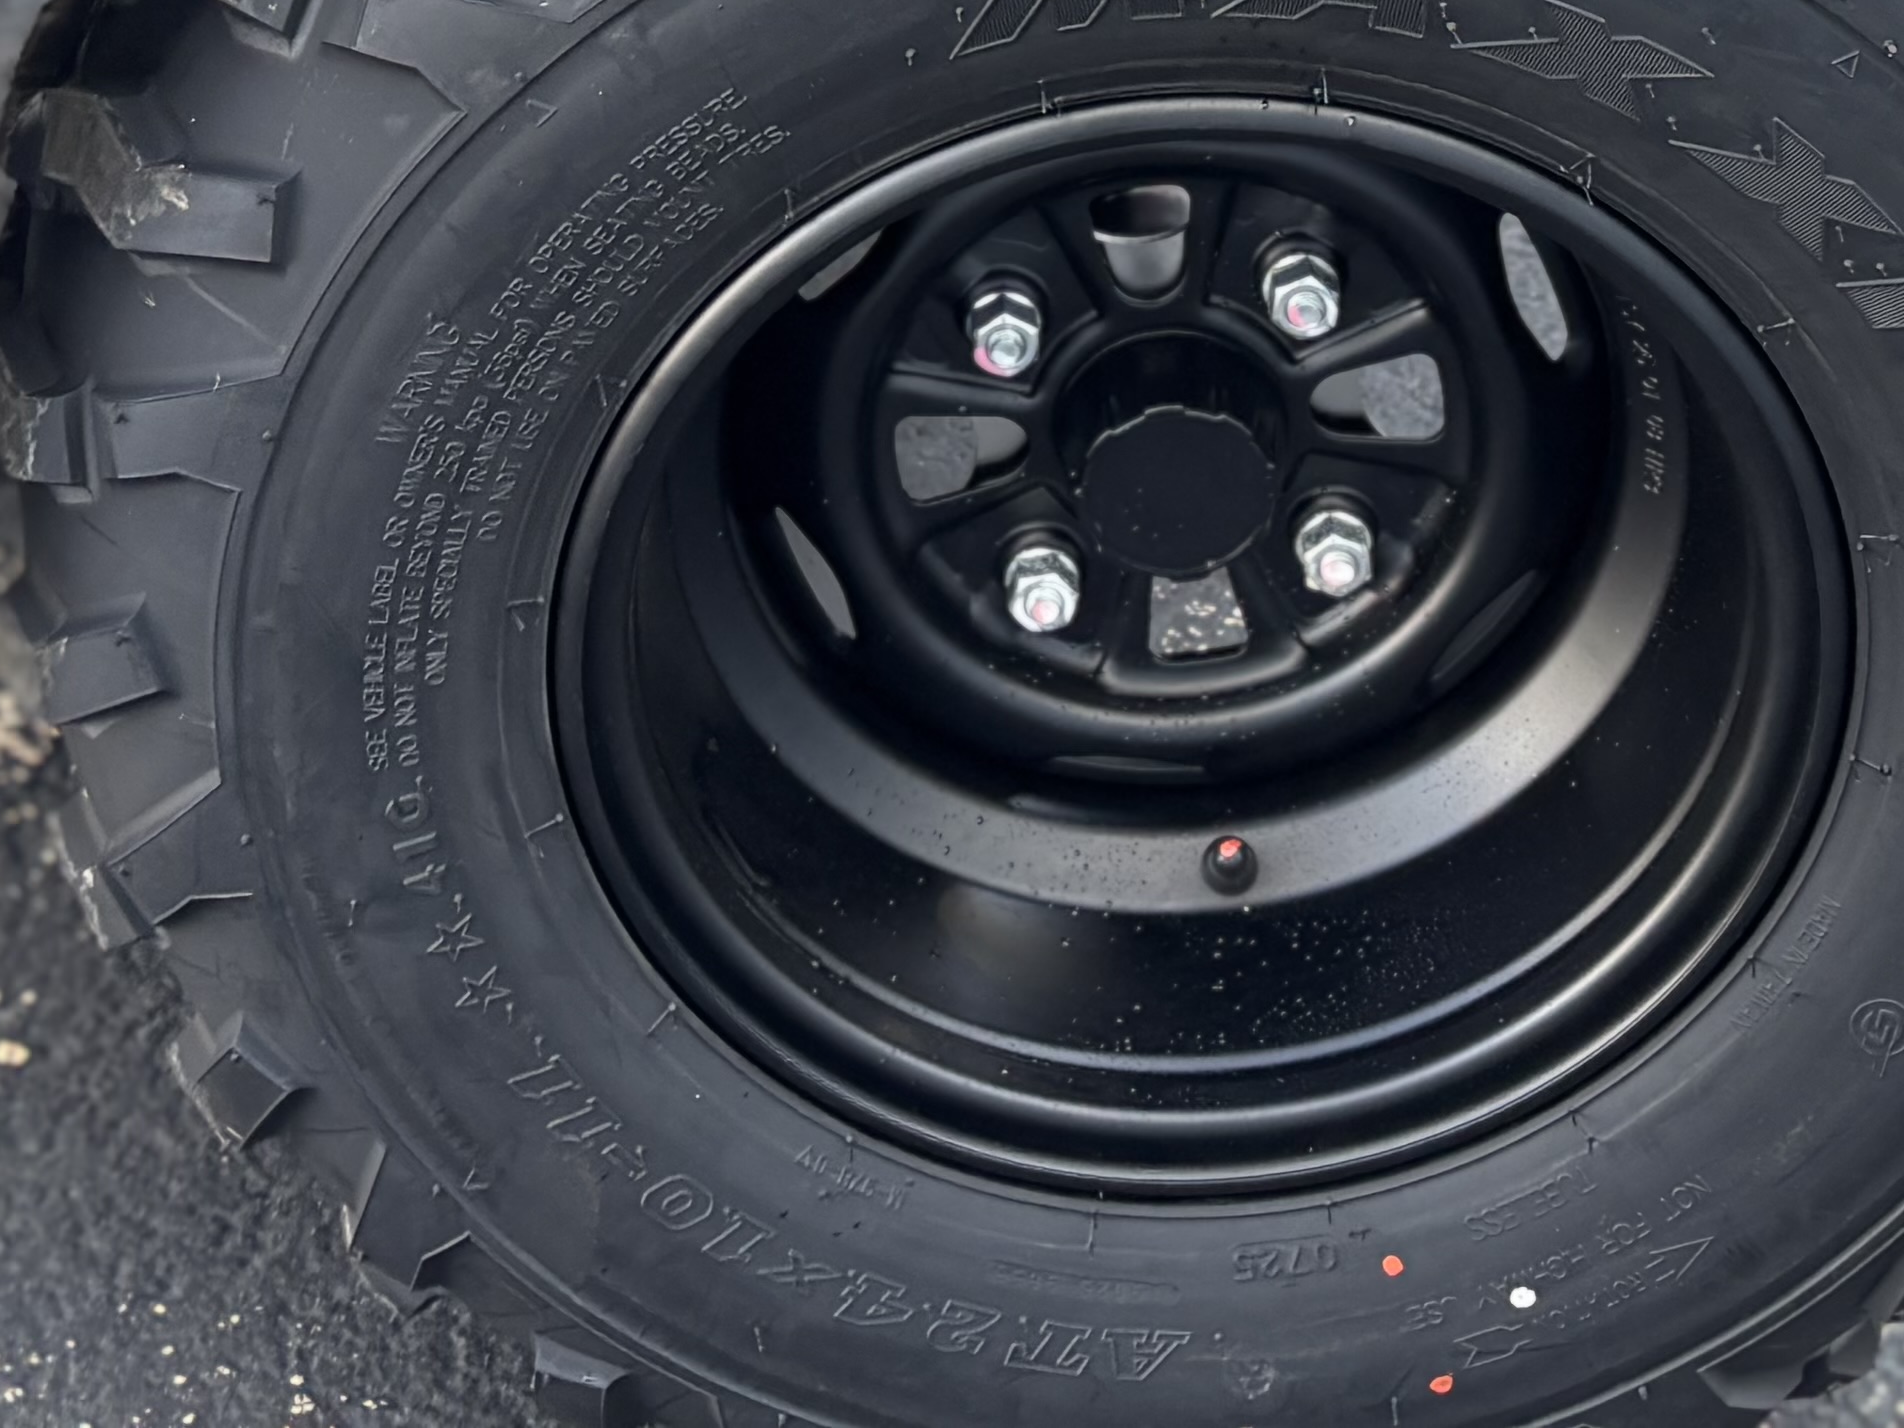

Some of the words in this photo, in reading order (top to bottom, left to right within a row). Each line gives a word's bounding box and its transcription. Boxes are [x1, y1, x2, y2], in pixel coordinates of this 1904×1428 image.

[663, 117, 749, 181] BEADS.
[525, 169, 635, 275] OPERATING
[580, 176, 669, 256] SEATING
[641, 169, 721, 234] MOUNT
[487, 275, 535, 322] FOR
[527, 254, 589, 315] WHEN
[569, 230, 650, 308] SHOULD
[502, 308, 579, 403] PERSONS
[557, 296, 626, 368] PAVED
[374, 313, 466, 447] WARNING
[433, 321, 501, 408] MANUAL
[535, 365, 573, 402] ON
[458, 407, 516, 497] TRAINED
[509, 404, 551, 452] USE
[392, 411, 449, 509] OWNER'S
[433, 438, 468, 483] 250
[487, 455, 526, 504] NOT
[380, 515, 410, 548] OR
[405, 490, 448, 577] BEYOND
[475, 508, 505, 542] DO
[367, 556, 399, 623] LABEL
[430, 503, 476, 619] SPECIALLY
[394, 584, 424, 672] INFLATE
[424, 627, 449, 685] ONLY
[362, 633, 388, 721] VEHICLE
[394, 683, 416, 727] NOT
[365, 729, 390, 772] SEE
[397, 733, 421, 766] DO
[1793, 892, 1843, 952] MADE
[1776, 942, 1813, 972] IN
[1651, 1172, 1714, 1222] NOT
[1592, 1209, 1655, 1256] FOR
[1393, 1293, 1463, 1333] USE
